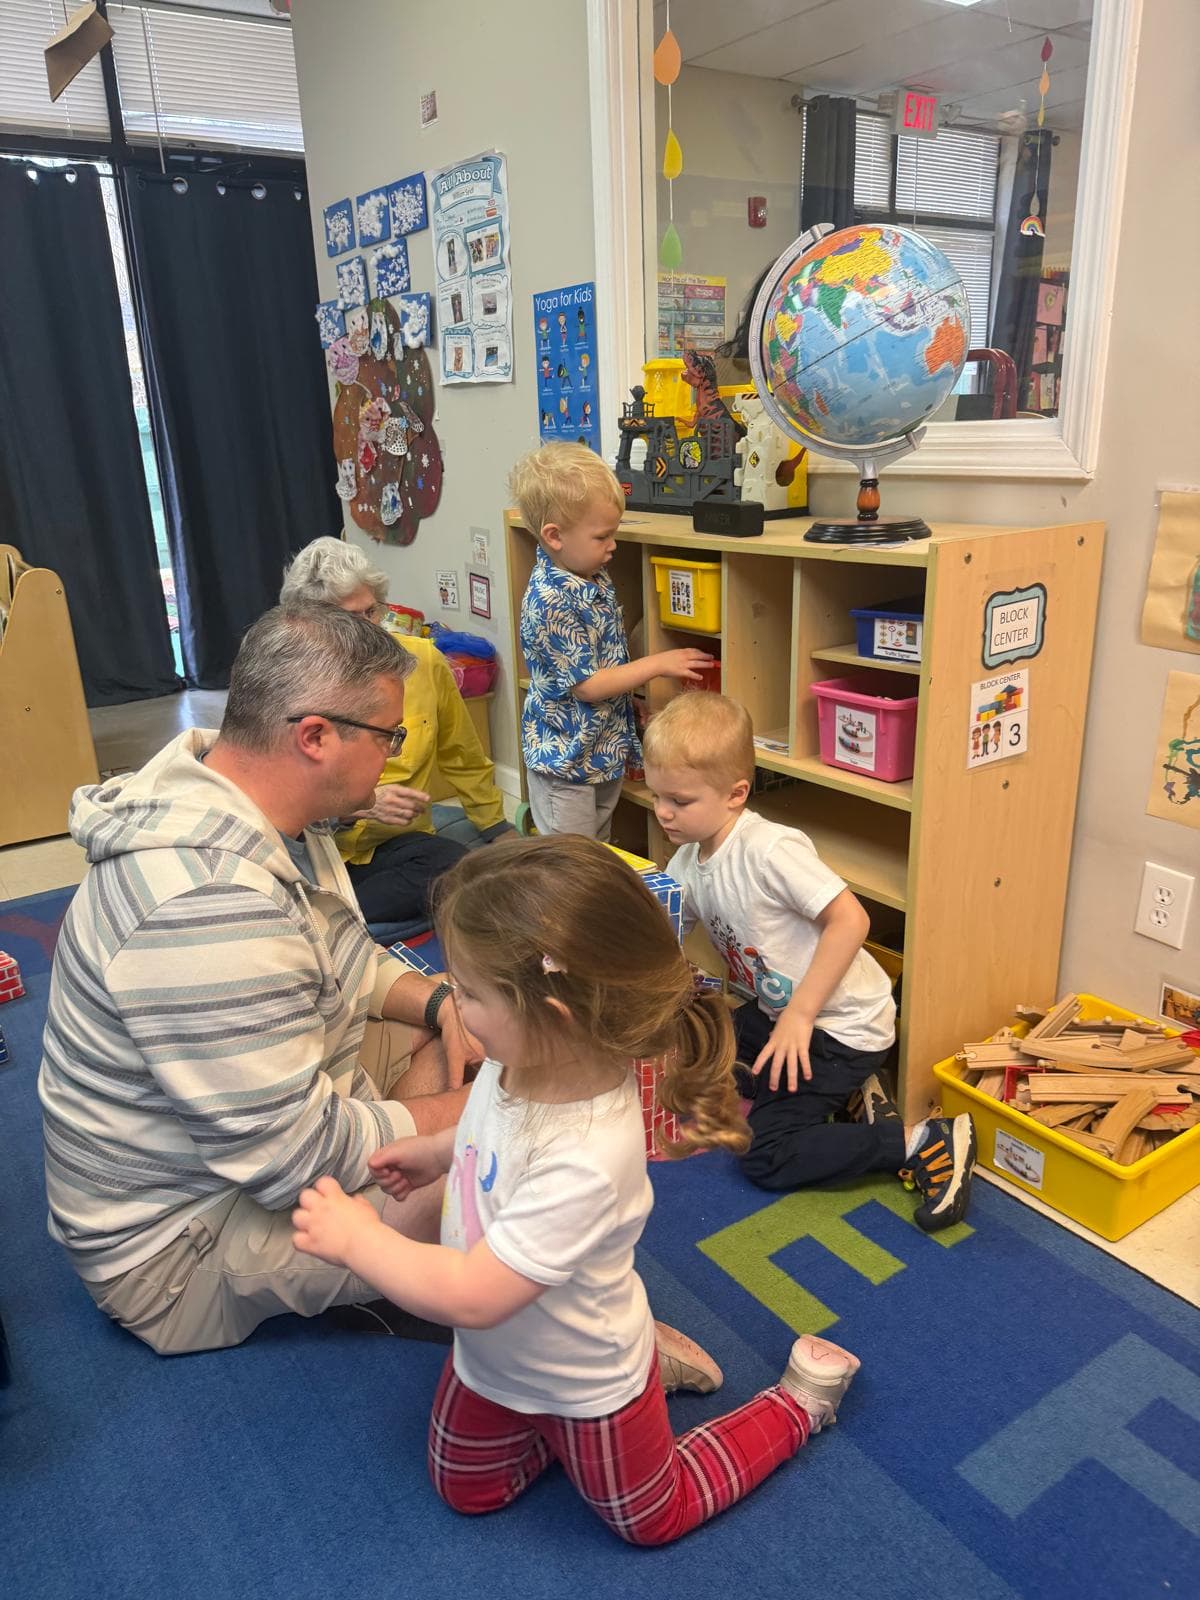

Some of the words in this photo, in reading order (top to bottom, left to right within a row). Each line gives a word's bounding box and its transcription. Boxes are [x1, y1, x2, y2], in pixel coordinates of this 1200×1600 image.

[904, 92, 937, 132] EXIT
[440, 175, 453, 194] All
[456, 165, 492, 186] About
[536, 297, 558, 313] Yoga
[560, 292, 573, 307] for
[574, 287, 592, 304] Kids
[451, 592, 456, 604] 2
[1000, 608, 1029, 624] BLOCK
[994, 627, 1029, 646] CENTER
[980, 680, 999, 690] BLOCK
[999, 673, 1021, 684] CENTER
[1009, 723, 1021, 746] 3
[761, 977, 786, 1001] C
